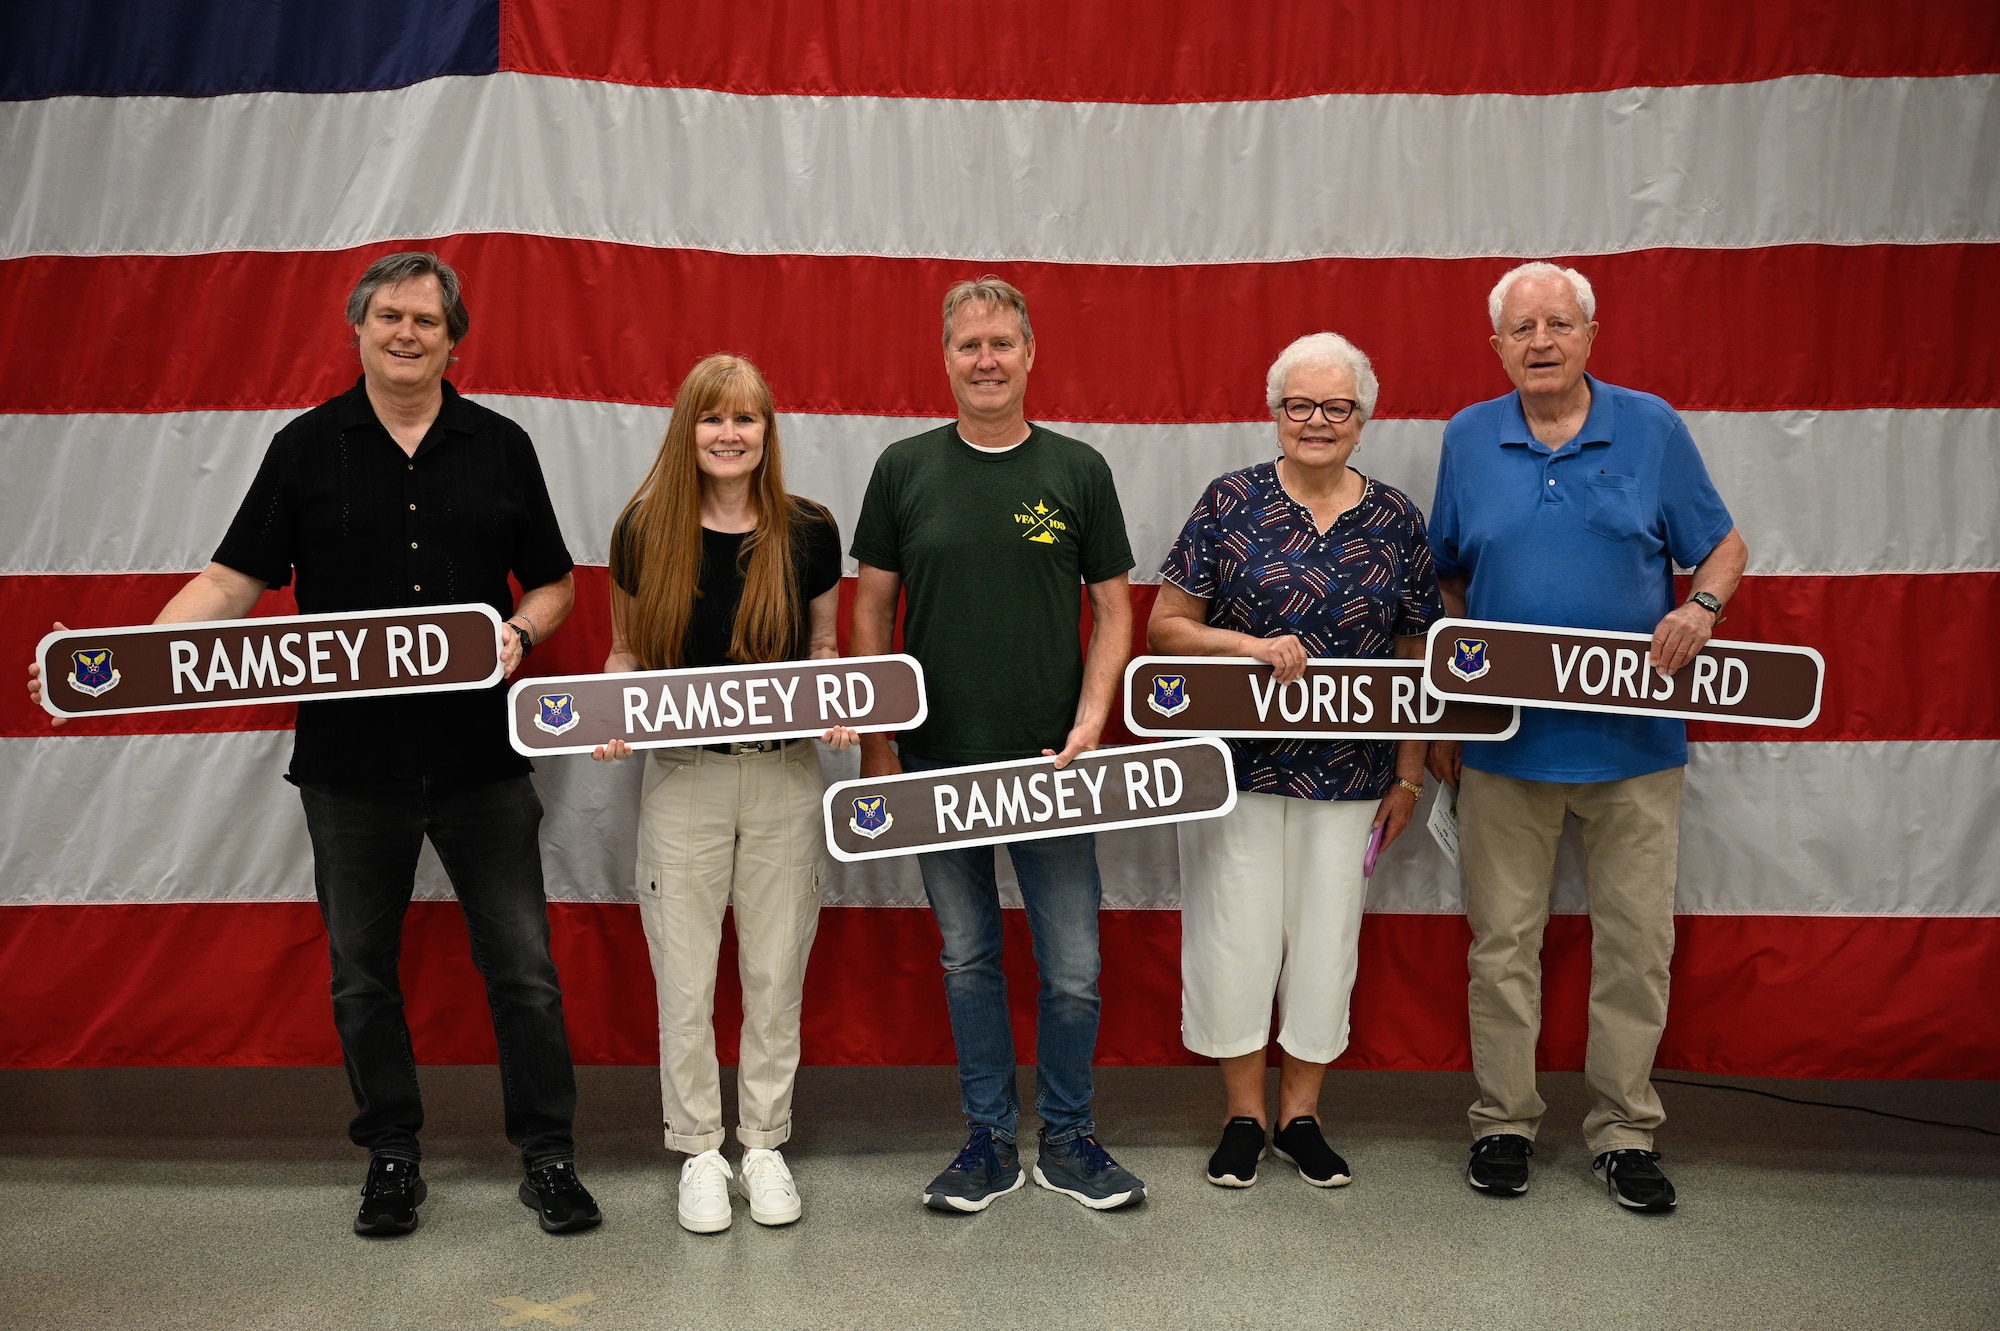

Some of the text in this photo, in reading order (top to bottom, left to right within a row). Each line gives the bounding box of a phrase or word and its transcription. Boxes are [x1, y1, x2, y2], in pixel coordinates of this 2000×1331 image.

[170, 624, 448, 694] RAMSEY RD
[1552, 644, 1748, 706] VORIS RD
[622, 672, 874, 733] RAMSEY RD
[1249, 674, 1373, 724] VORIS
[934, 758, 1182, 833] RAMSEY RD
